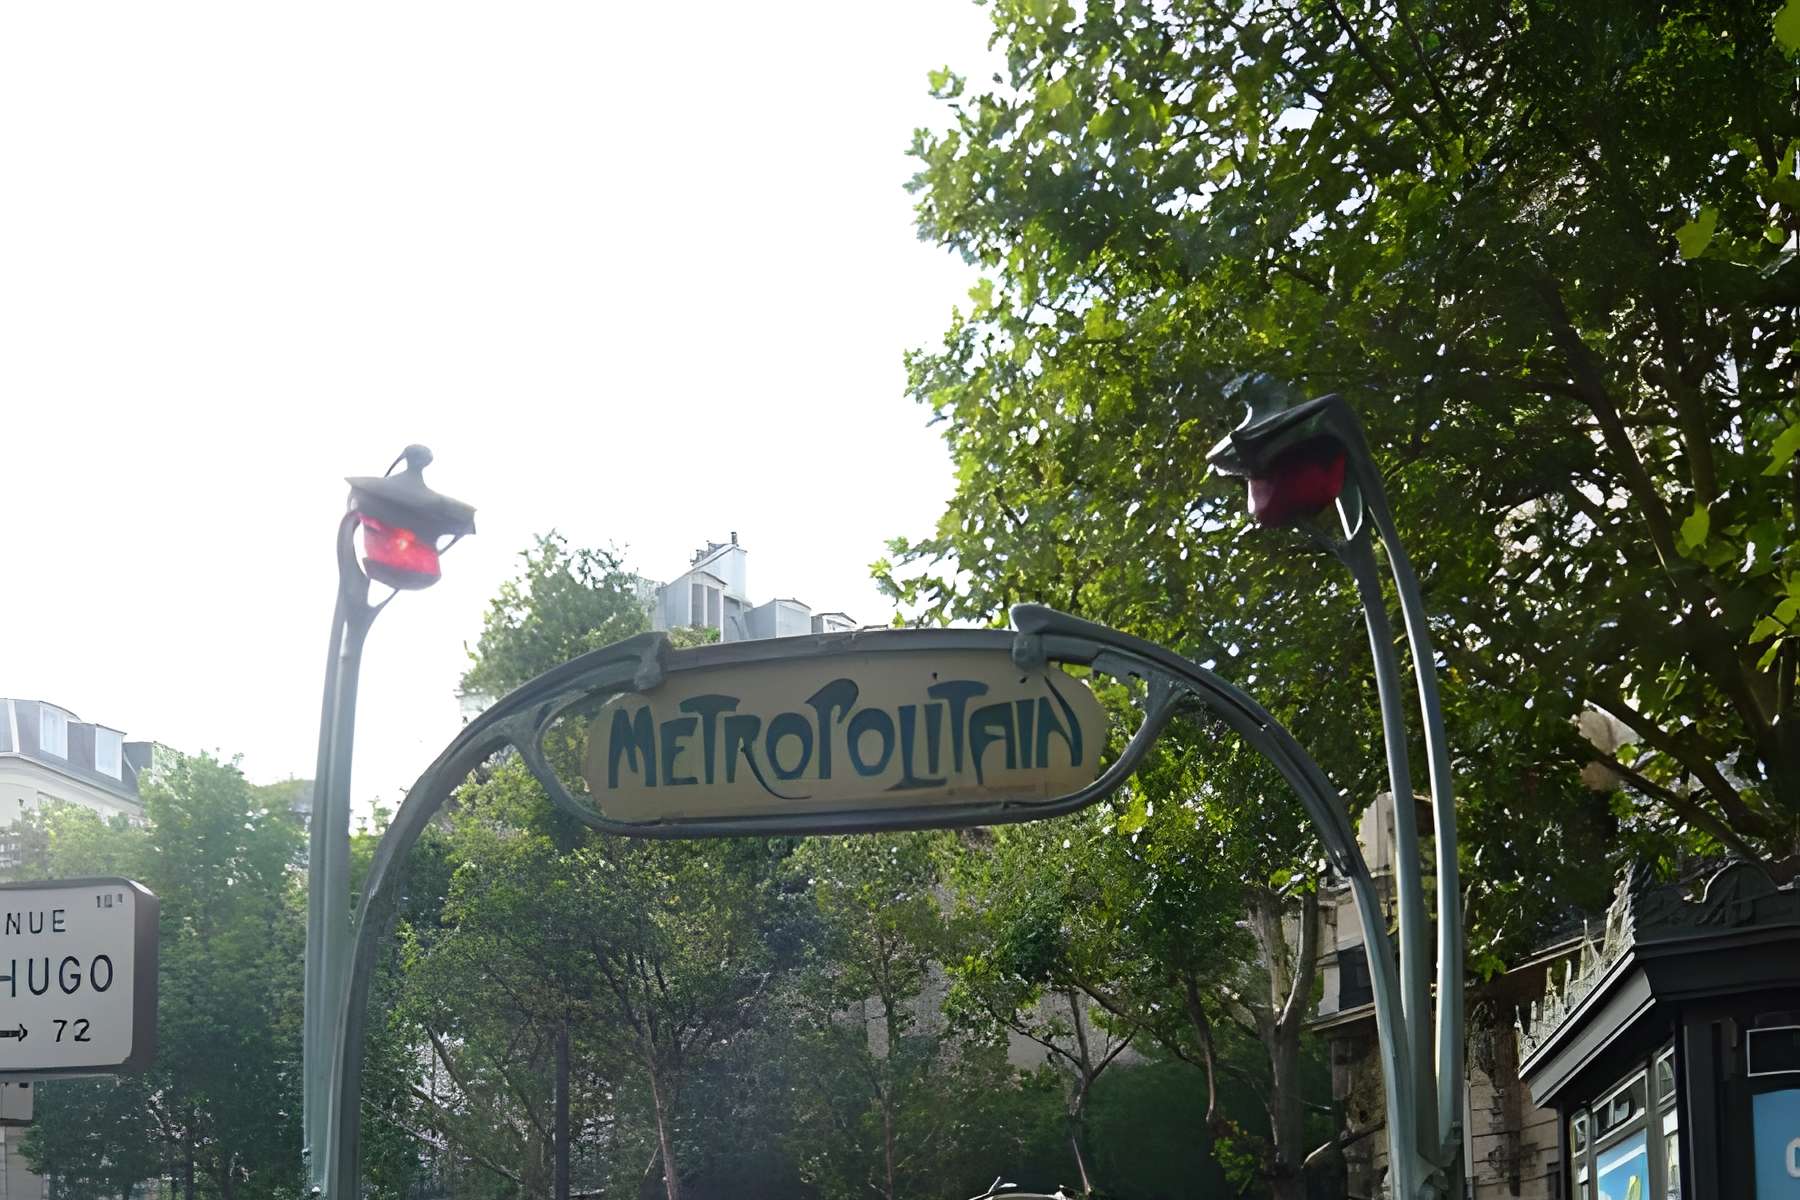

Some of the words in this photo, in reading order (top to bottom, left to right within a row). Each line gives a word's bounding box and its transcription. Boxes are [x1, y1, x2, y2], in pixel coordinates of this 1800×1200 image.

[607, 676, 1084, 800] METROPOLITAIN
[5, 909, 67, 936] NUE
[0, 954, 114, 998] HUGO
[52, 1018, 92, 1043] 72
